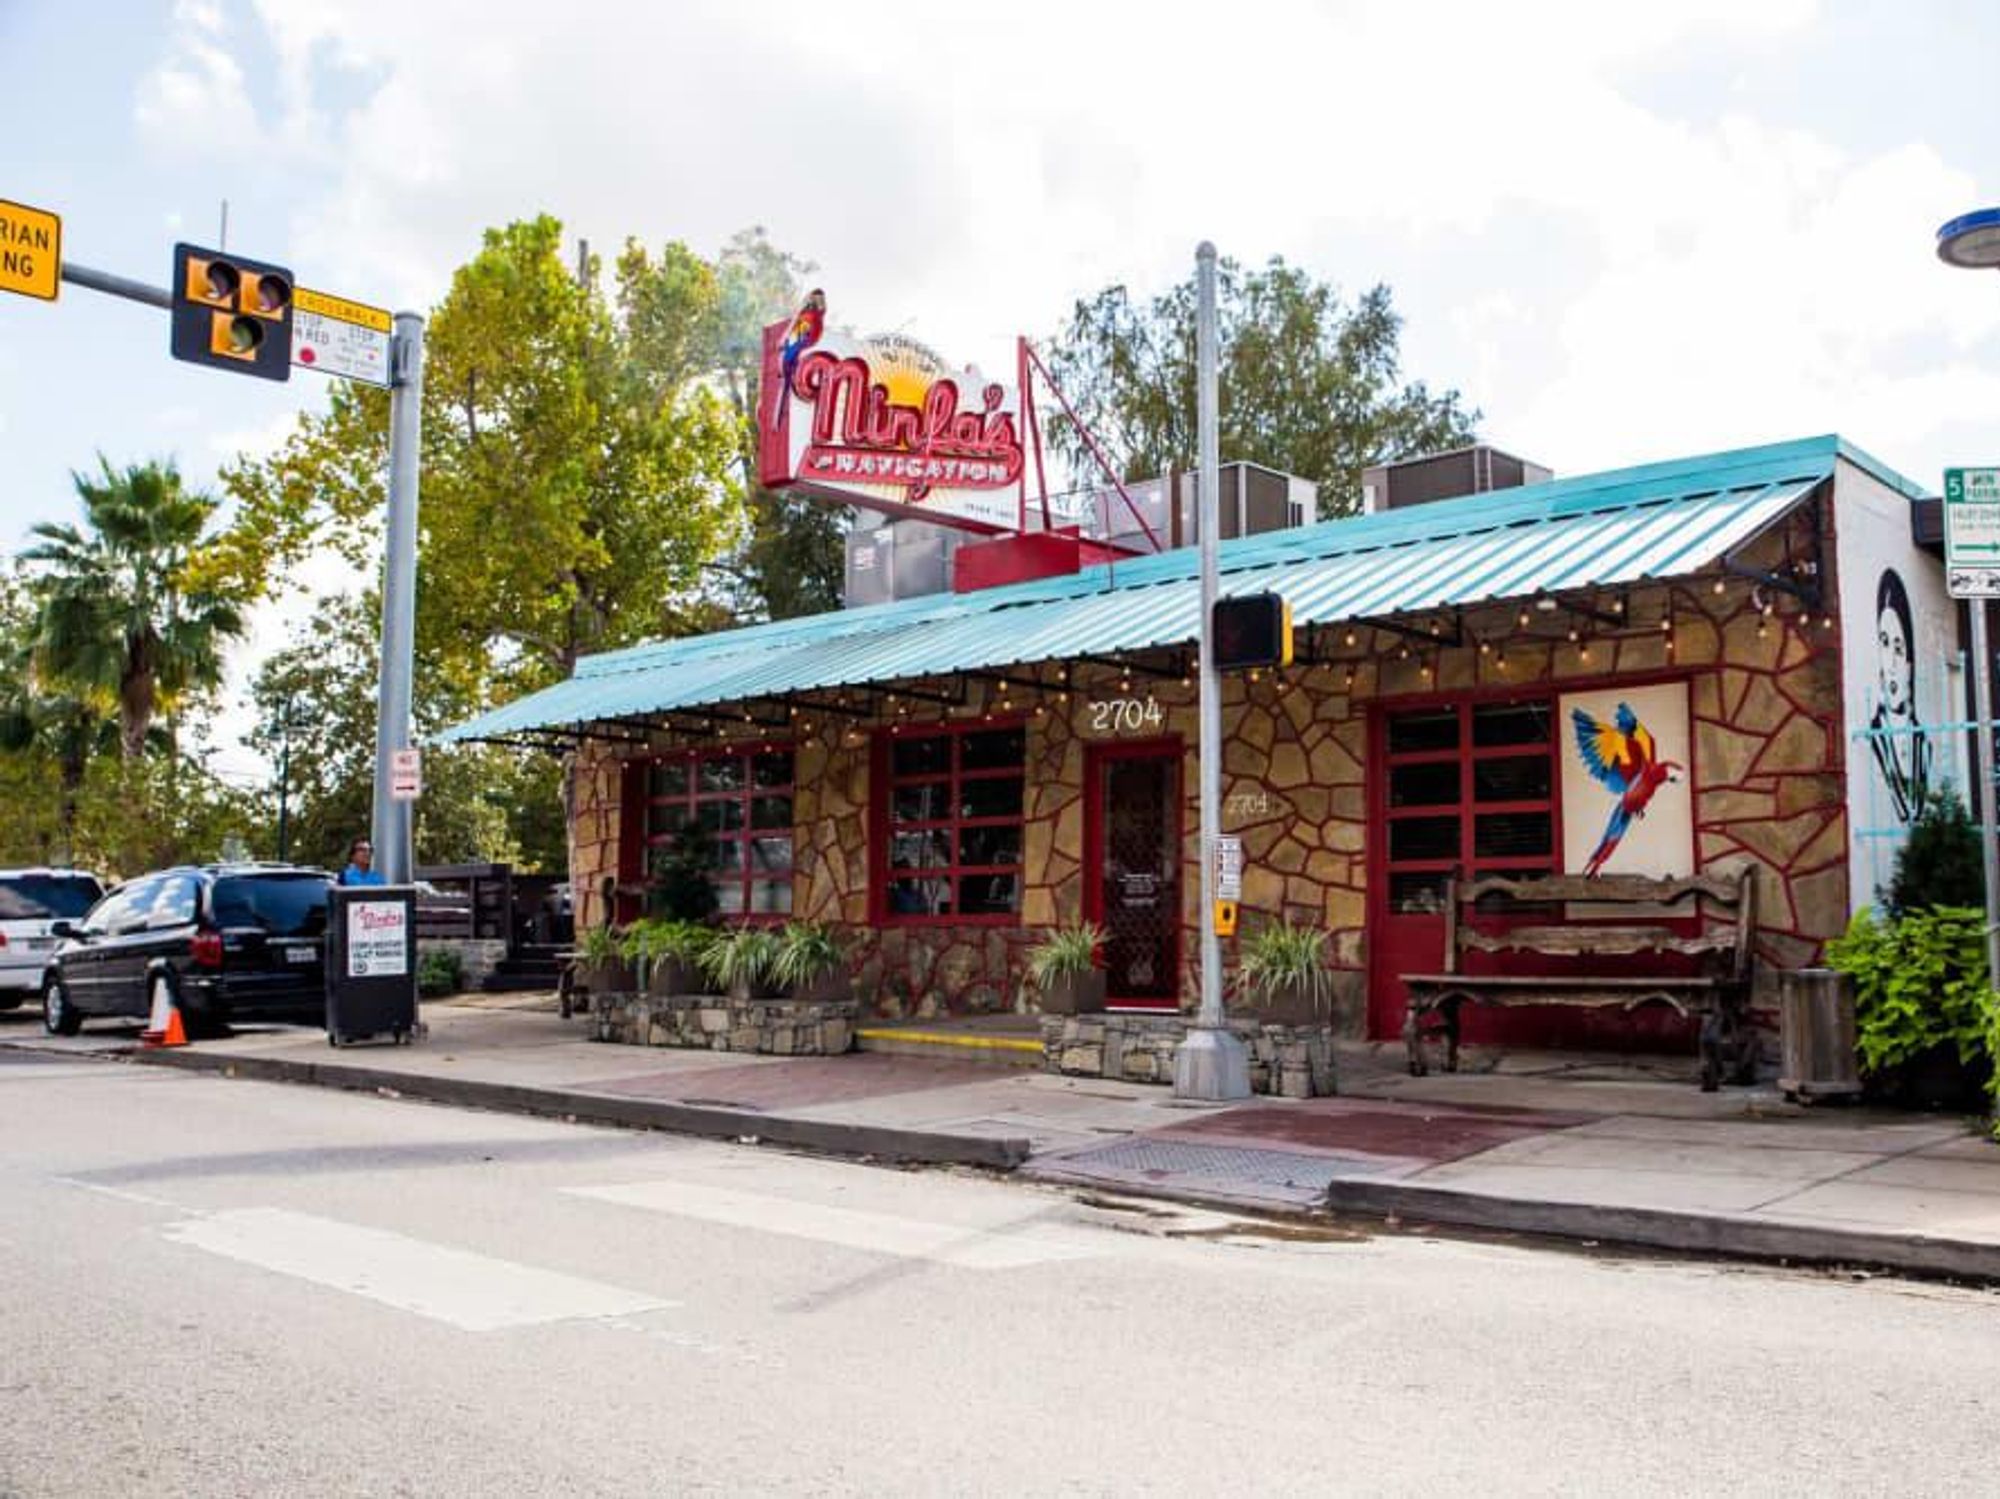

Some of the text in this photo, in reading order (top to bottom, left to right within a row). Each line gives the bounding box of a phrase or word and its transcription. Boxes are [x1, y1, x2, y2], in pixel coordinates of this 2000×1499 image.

[792, 351, 1017, 497] Ninfa's
[834, 453, 1009, 483] NAVIGATION
[1949, 478, 1961, 496] 5
[1088, 696, 1162, 730] 2704
